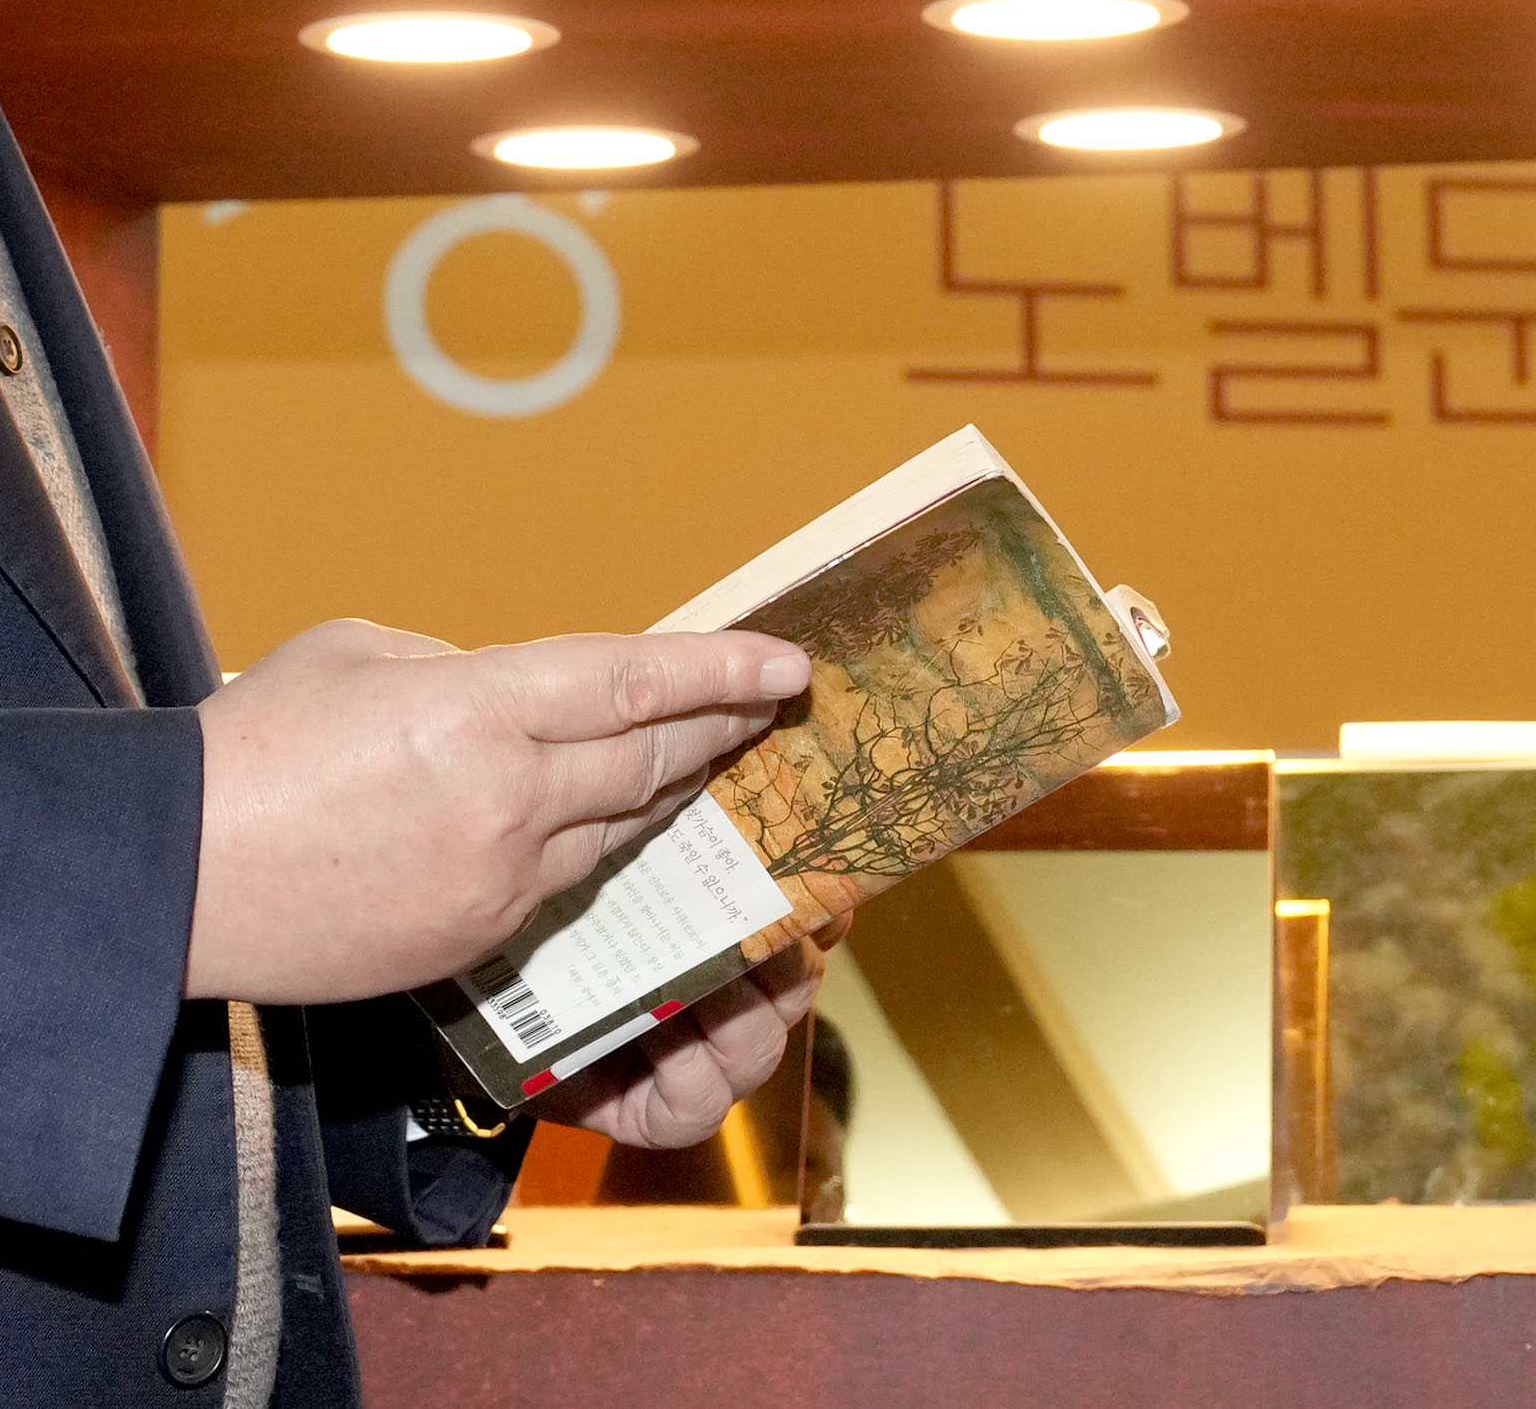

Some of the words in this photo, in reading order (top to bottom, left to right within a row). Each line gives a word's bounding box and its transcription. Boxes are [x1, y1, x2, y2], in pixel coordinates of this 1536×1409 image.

[678, 839, 701, 864] 죽일
[694, 863, 708, 875] 수
[714, 846, 739, 874] 좋아.
[539, 1009, 562, 1034] 03810
